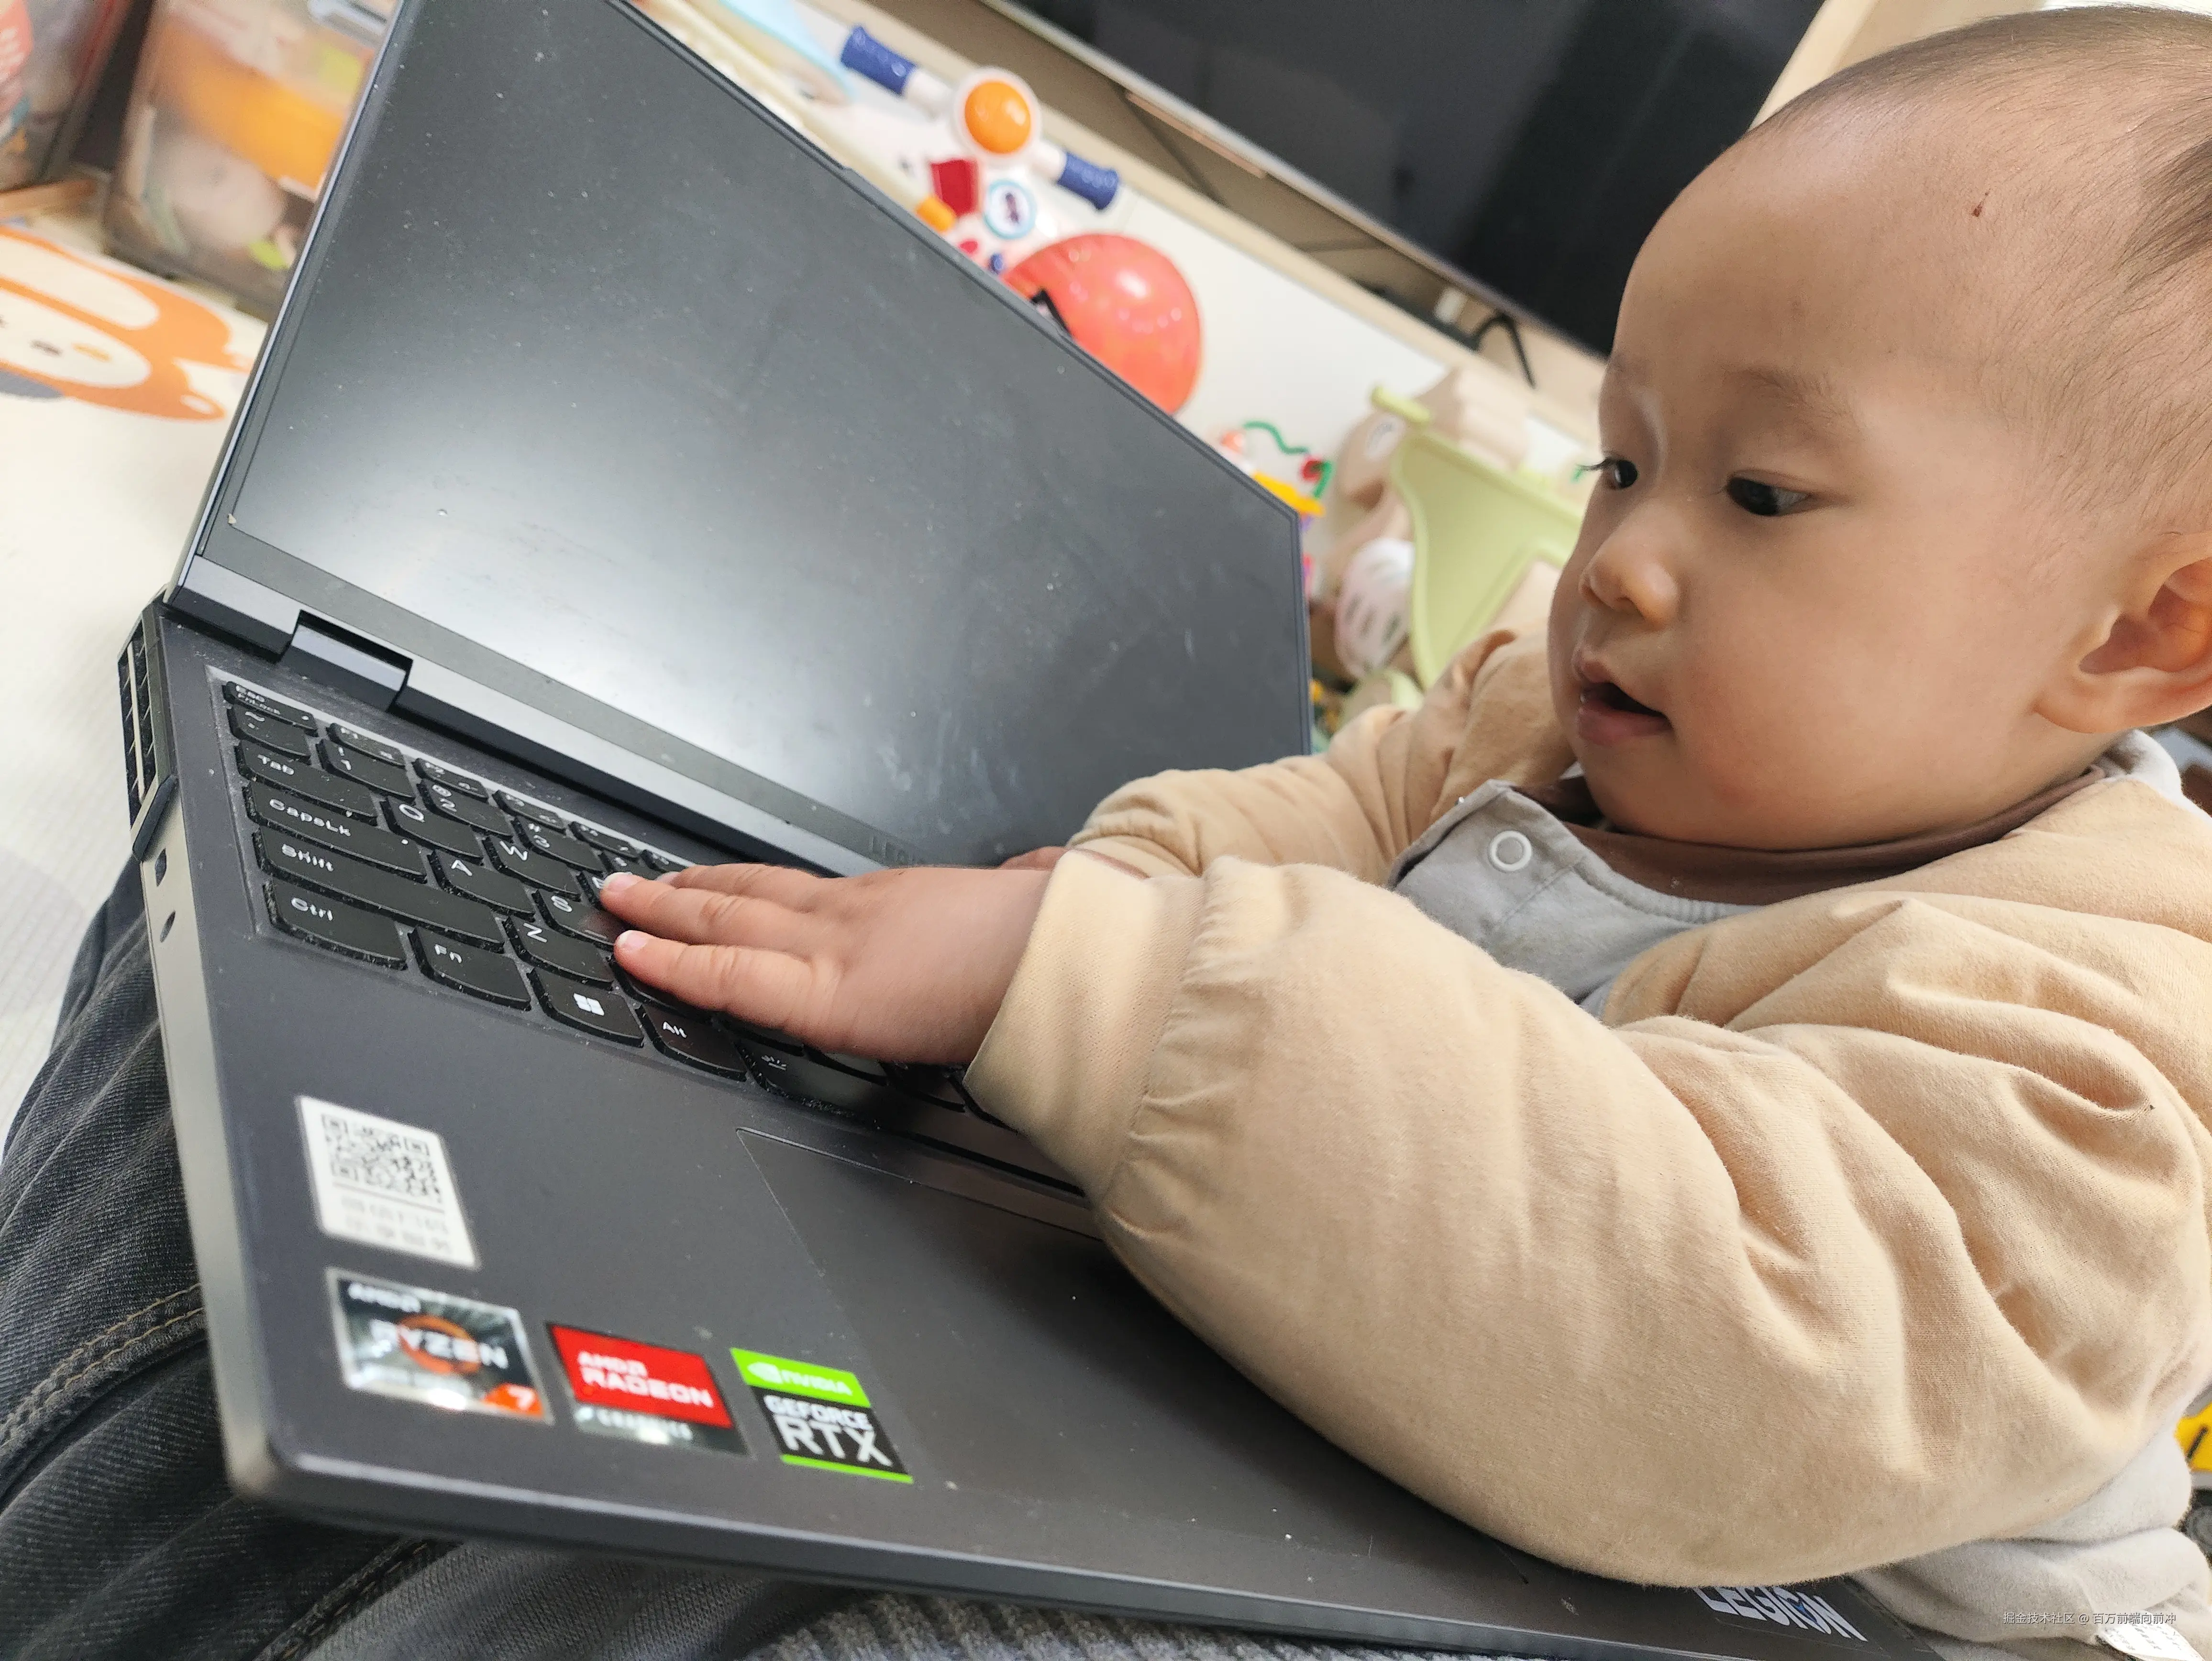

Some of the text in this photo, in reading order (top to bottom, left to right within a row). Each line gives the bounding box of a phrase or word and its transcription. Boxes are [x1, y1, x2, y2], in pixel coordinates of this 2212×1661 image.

[257, 754, 294, 775] Tab
[340, 759, 352, 771] 1
[440, 797, 457, 812] 2
[269, 799, 351, 837] CapsLk
[281, 843, 334, 872] Shift
[499, 840, 528, 861] W
[451, 859, 473, 876] A
[291, 897, 333, 921] Ctrl
[551, 895, 573, 913] S
[522, 922, 548, 943] Z
[434, 944, 463, 963] Fn
[663, 1021, 687, 1038] Alt
[580, 1366, 714, 1408] RADEON
[507, 1386, 535, 1411] 7
[764, 1395, 874, 1430] GEFORCE
[774, 1413, 893, 1467] RTX
